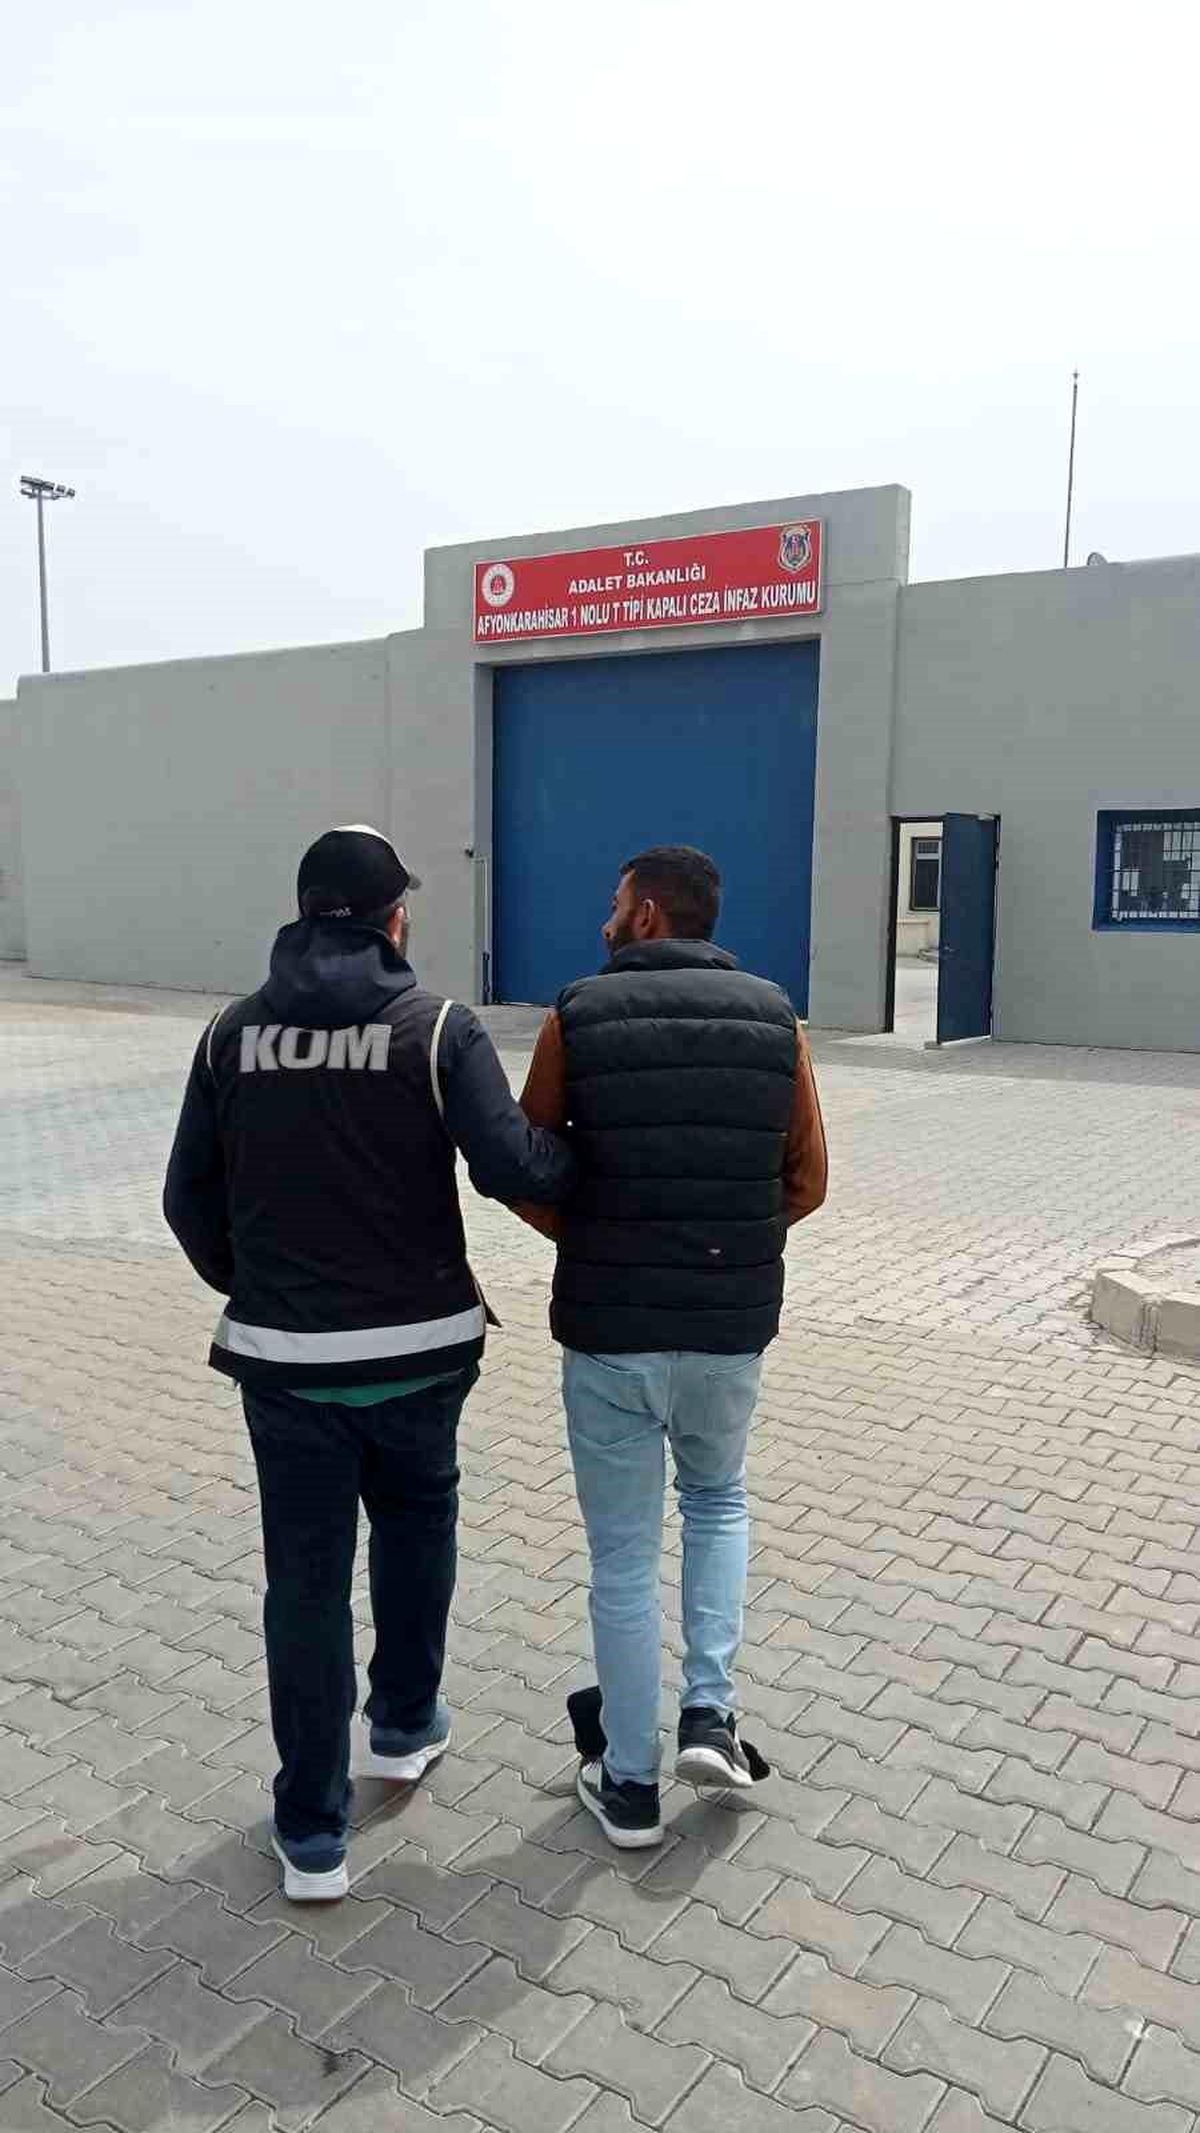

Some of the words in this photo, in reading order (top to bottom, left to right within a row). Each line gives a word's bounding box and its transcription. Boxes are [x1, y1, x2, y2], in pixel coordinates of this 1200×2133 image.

[568, 575, 623, 595] ADALET
[626, 563, 706, 589] BAKANLIĞI
[624, 551, 649, 567] T.C.
[477, 603, 569, 636] AFYONKARAHİSAR
[571, 607, 578, 628] 1
[581, 602, 610, 627] NOLU
[612, 602, 621, 623] T
[623, 596, 645, 622] TİPİ
[647, 594, 688, 620] KAPALI
[690, 591, 720, 615] CEZA
[724, 584, 758, 612] İNFAZ
[761, 580, 816, 608] KURUMU
[239, 1023, 393, 1074] KOM
